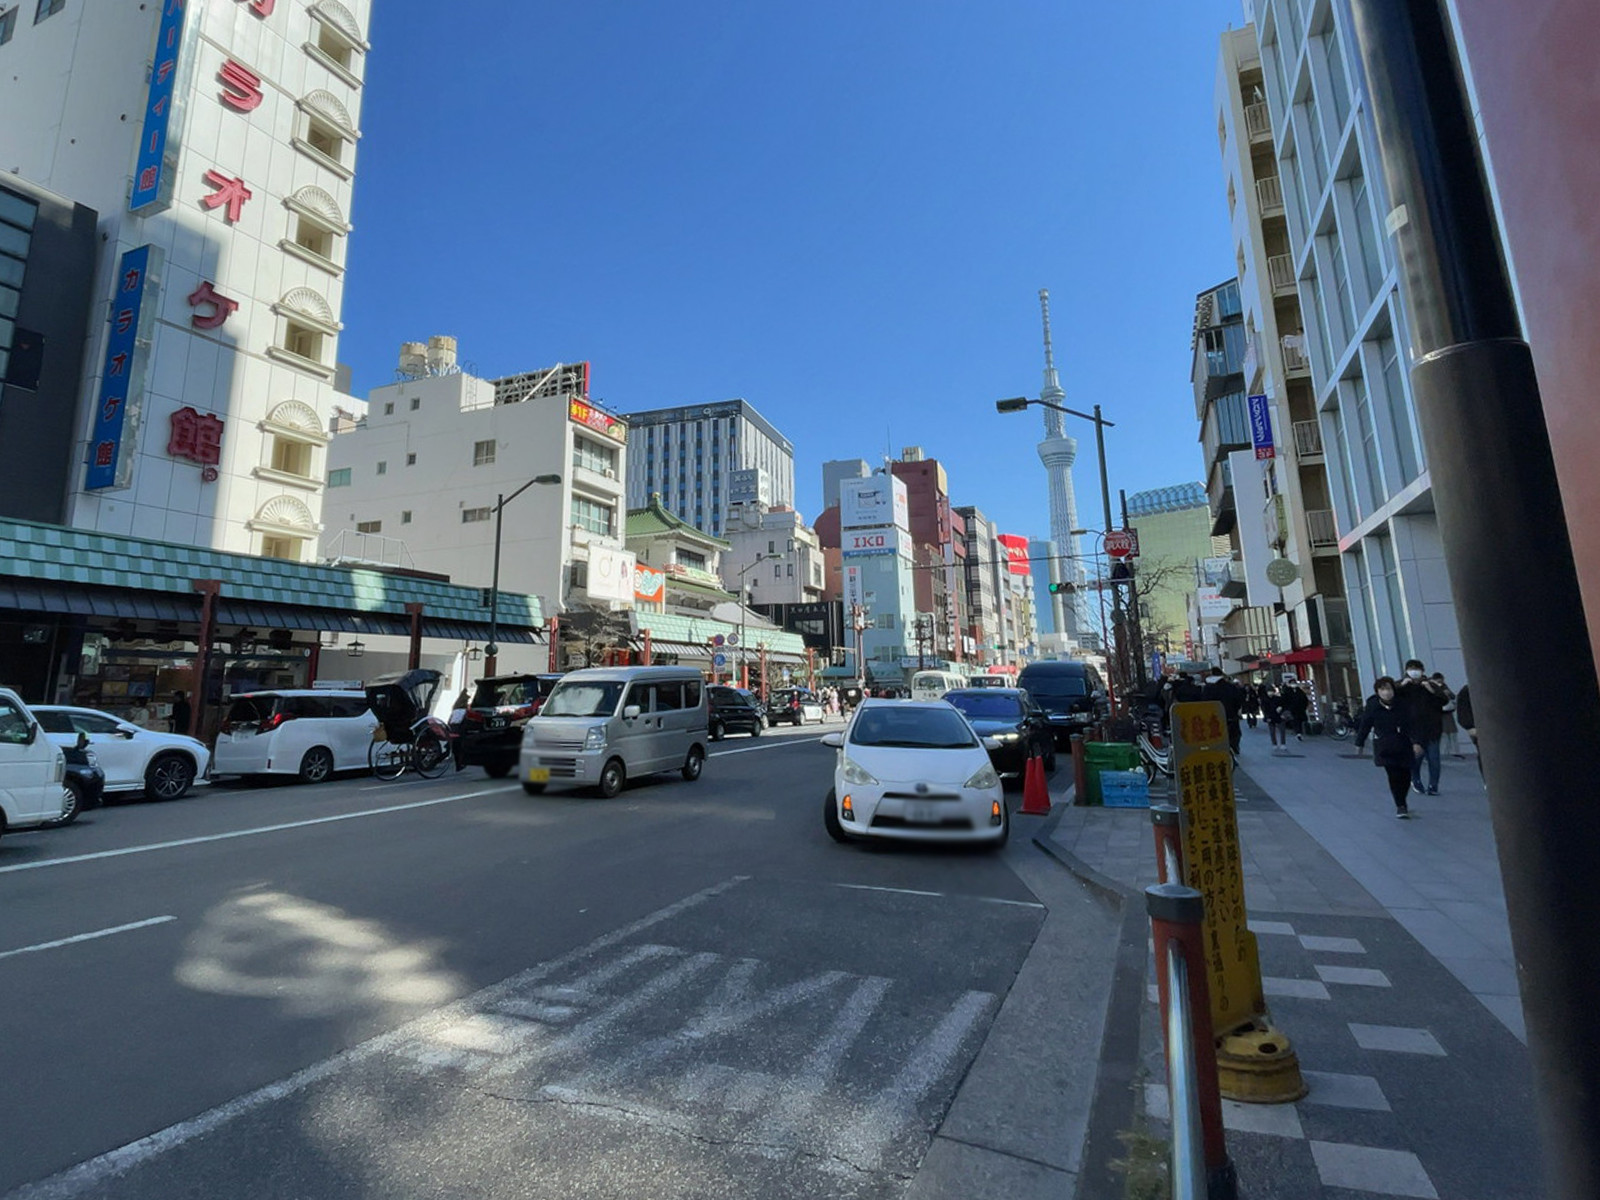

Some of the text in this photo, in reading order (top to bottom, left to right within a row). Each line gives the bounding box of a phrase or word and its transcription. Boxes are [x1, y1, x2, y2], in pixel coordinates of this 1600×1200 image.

[95, 269, 139, 467] カラオケ館
